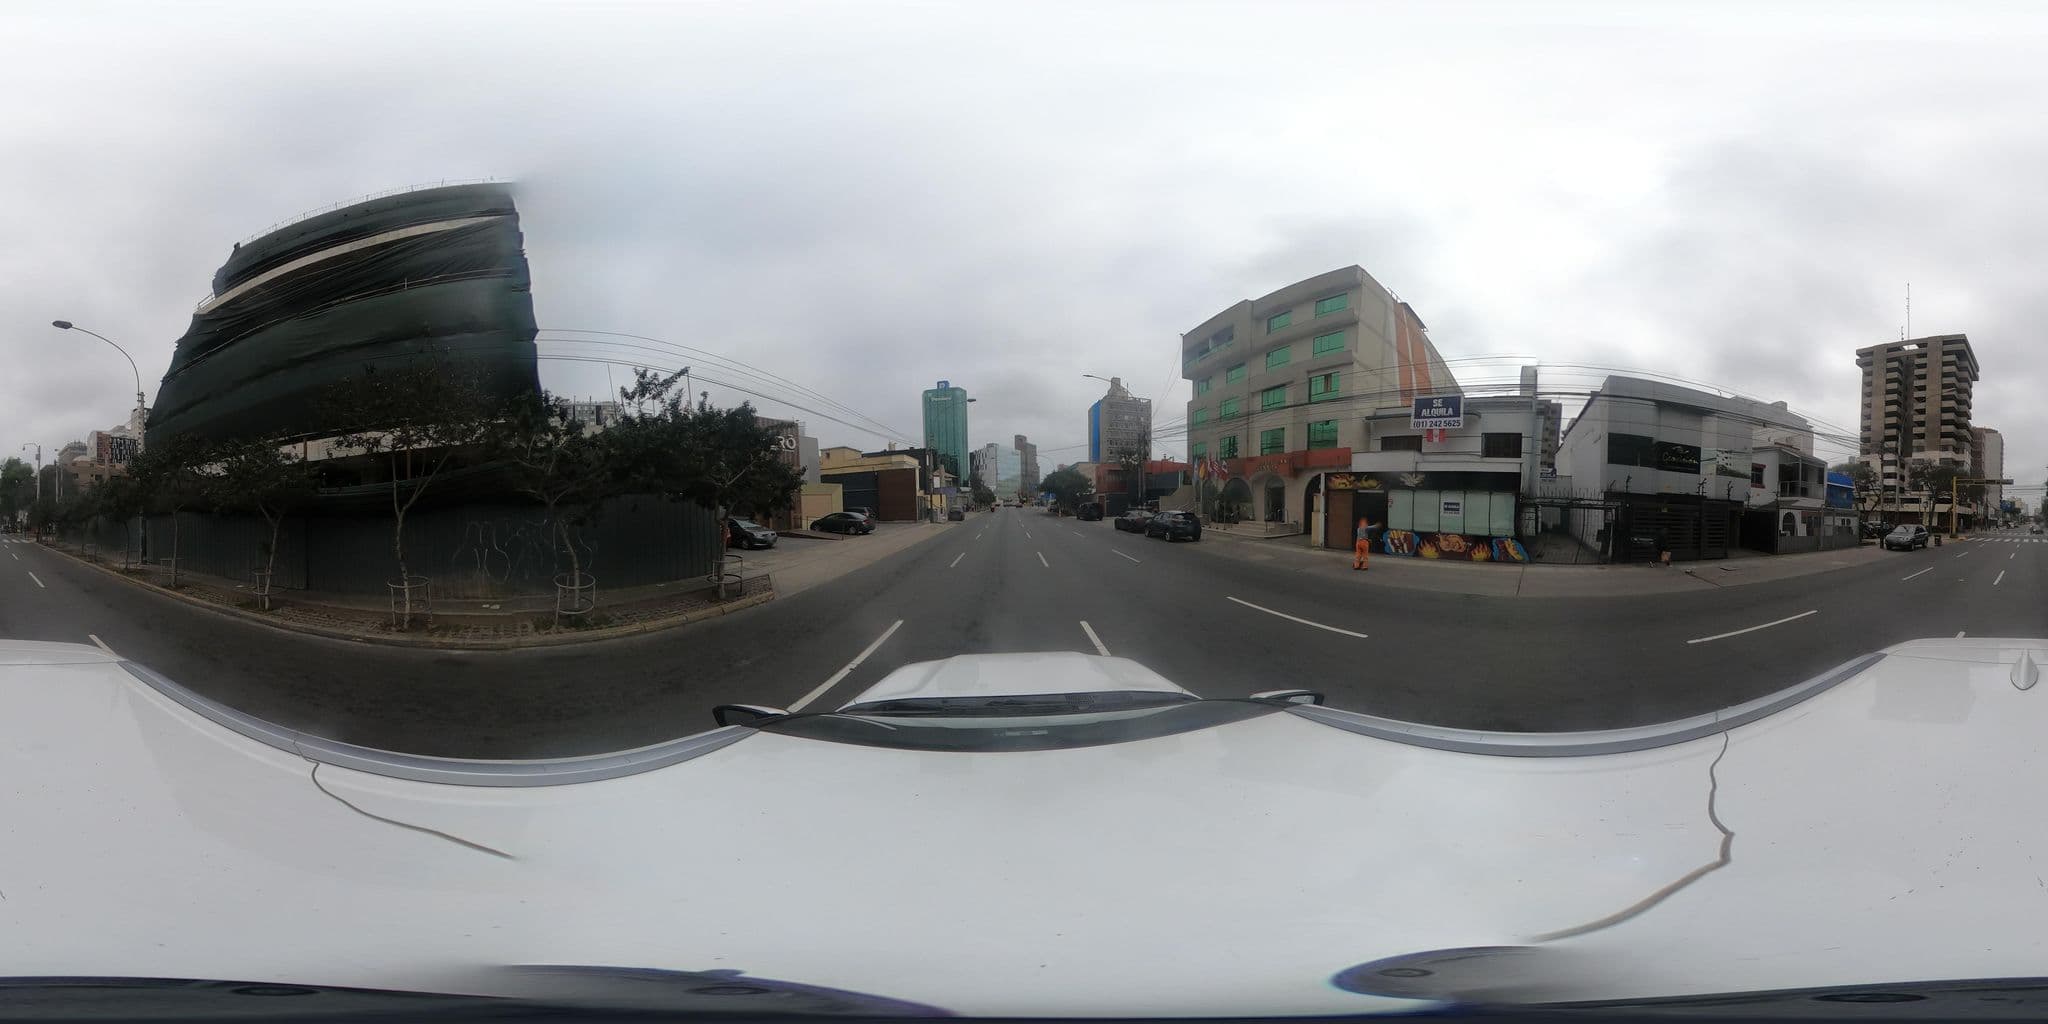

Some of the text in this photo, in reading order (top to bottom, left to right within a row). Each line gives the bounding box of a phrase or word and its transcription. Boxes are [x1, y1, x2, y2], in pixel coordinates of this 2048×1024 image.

[1432, 398, 1443, 407] SE
[1421, 407, 1454, 417] ALQUILA
[1413, 419, 1461, 428] (01) 242 5625
